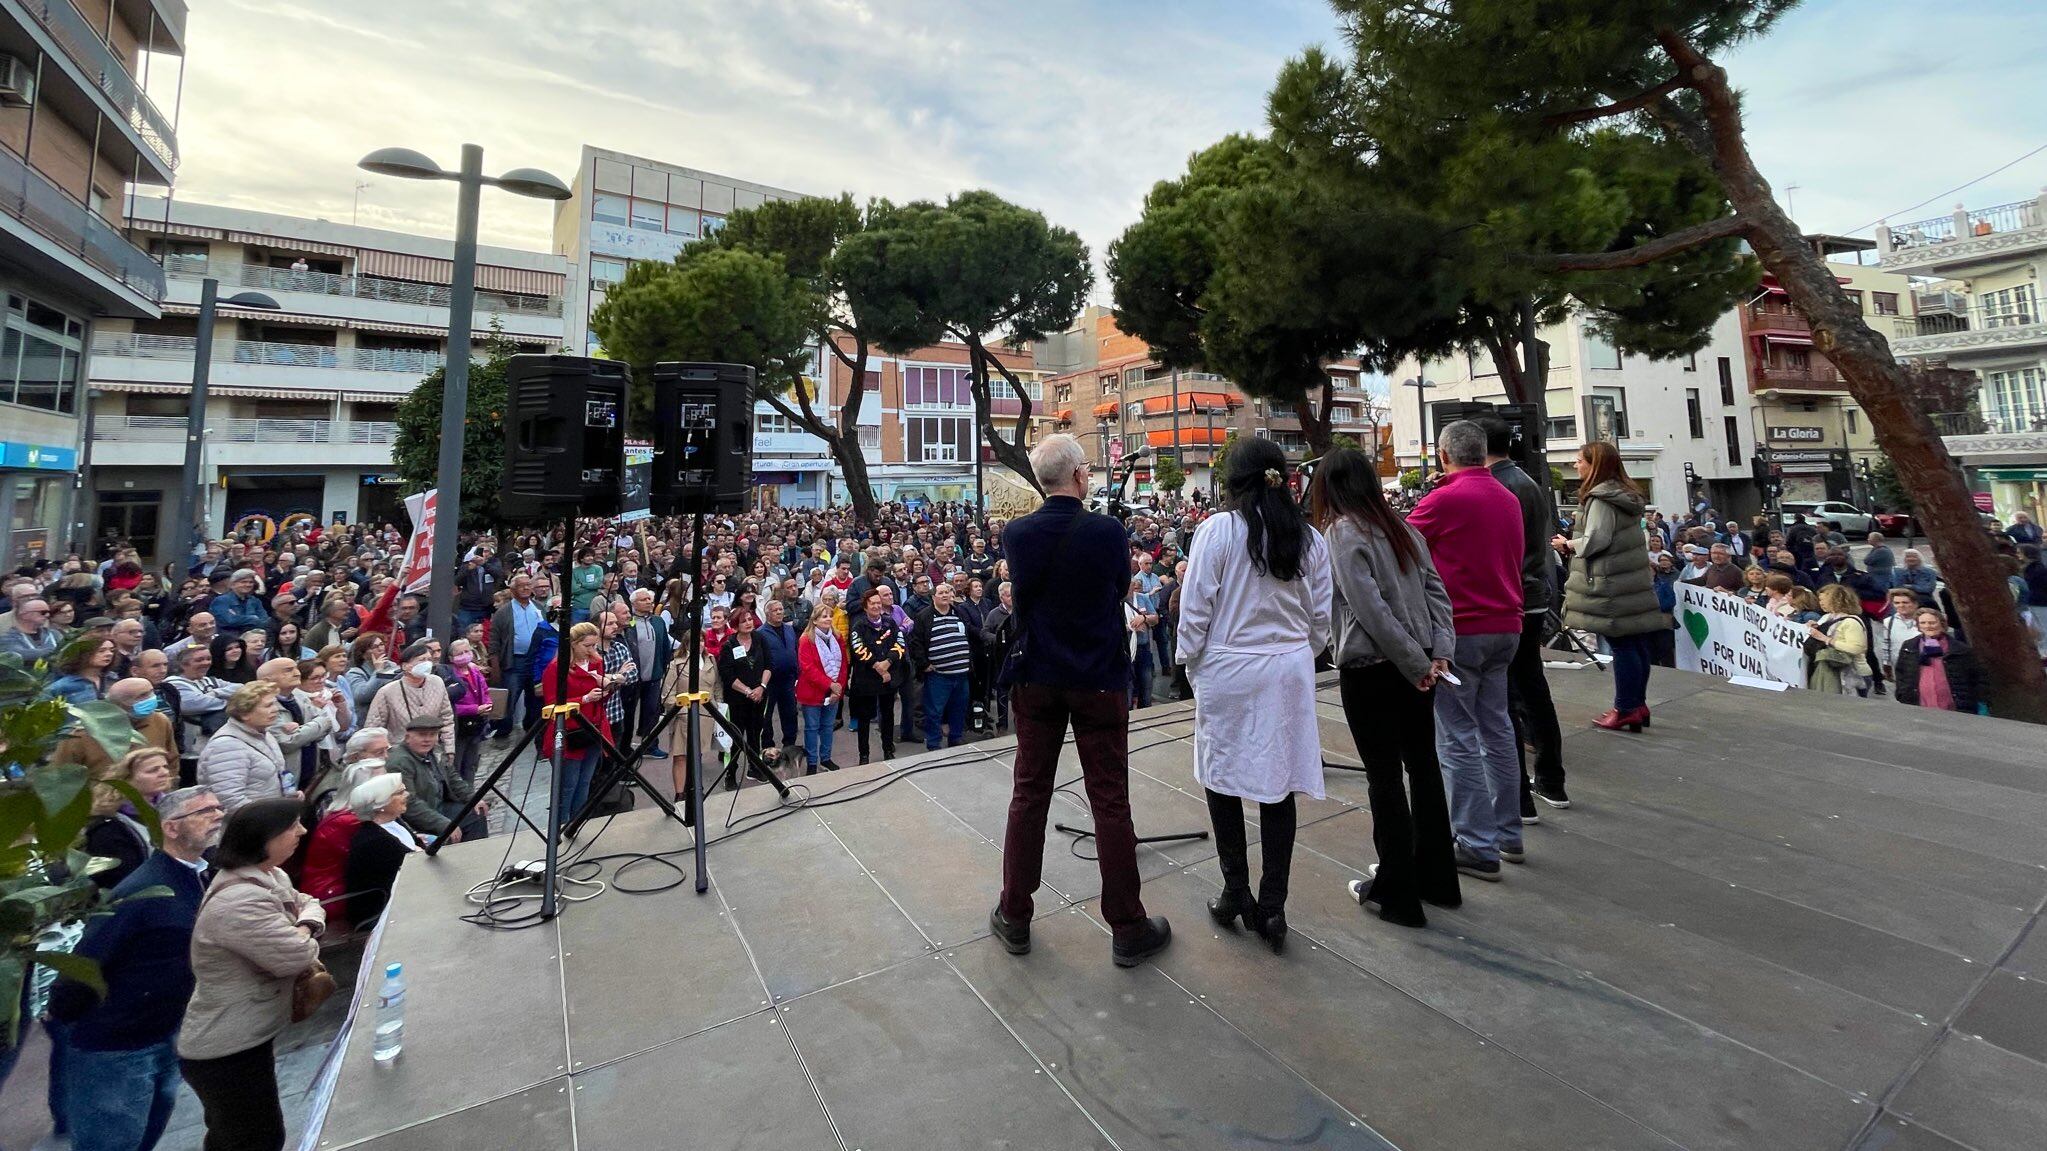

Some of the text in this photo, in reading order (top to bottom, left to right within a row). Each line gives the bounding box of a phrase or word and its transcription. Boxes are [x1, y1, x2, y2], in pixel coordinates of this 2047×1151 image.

[754, 437, 772, 447] fael
[1774, 428, 1819, 438] La Gloria
[1684, 589, 1707, 608] A.V.
[1711, 595, 1739, 618] SAN
[1713, 641, 1735, 665] POR
[1740, 652, 1764, 679] UNA
